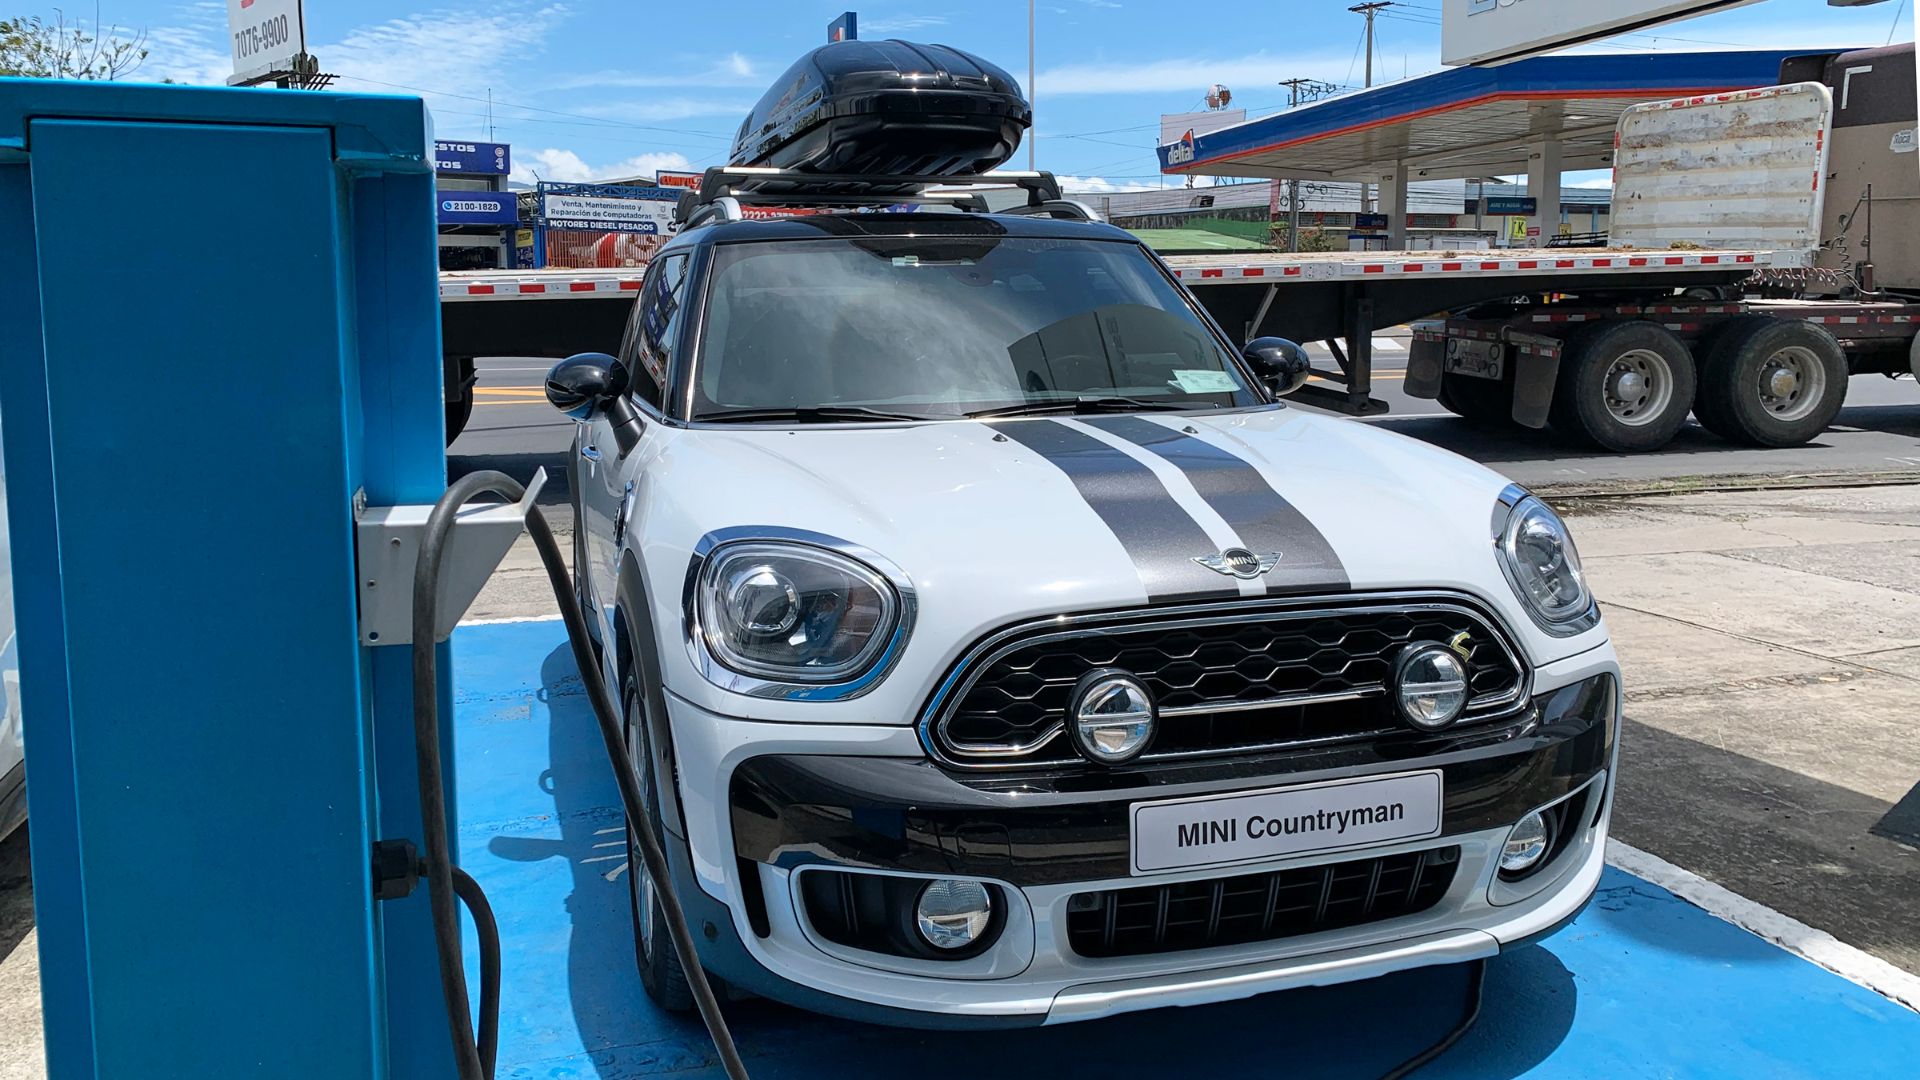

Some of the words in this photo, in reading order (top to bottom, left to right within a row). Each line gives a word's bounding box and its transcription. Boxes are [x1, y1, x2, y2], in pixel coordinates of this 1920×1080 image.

[235, 14, 288, 59] 7076-9900
[1167, 142, 1194, 165] delta
[454, 202, 498, 210] 2100-1828
[561, 200, 583, 208] Venta,
[585, 201, 636, 210] Mantenimiento
[551, 208, 591, 217] Reparación
[593, 209, 601, 217] de
[602, 211, 652, 220] Computadoras
[550, 219, 589, 228] MOTORES
[590, 221, 617, 230] DIESEL
[618, 222, 654, 231] PESADOS
[1227, 556, 1257, 566] MINI
[1177, 818, 1237, 848] MINI
[1246, 802, 1404, 840] Countryman
